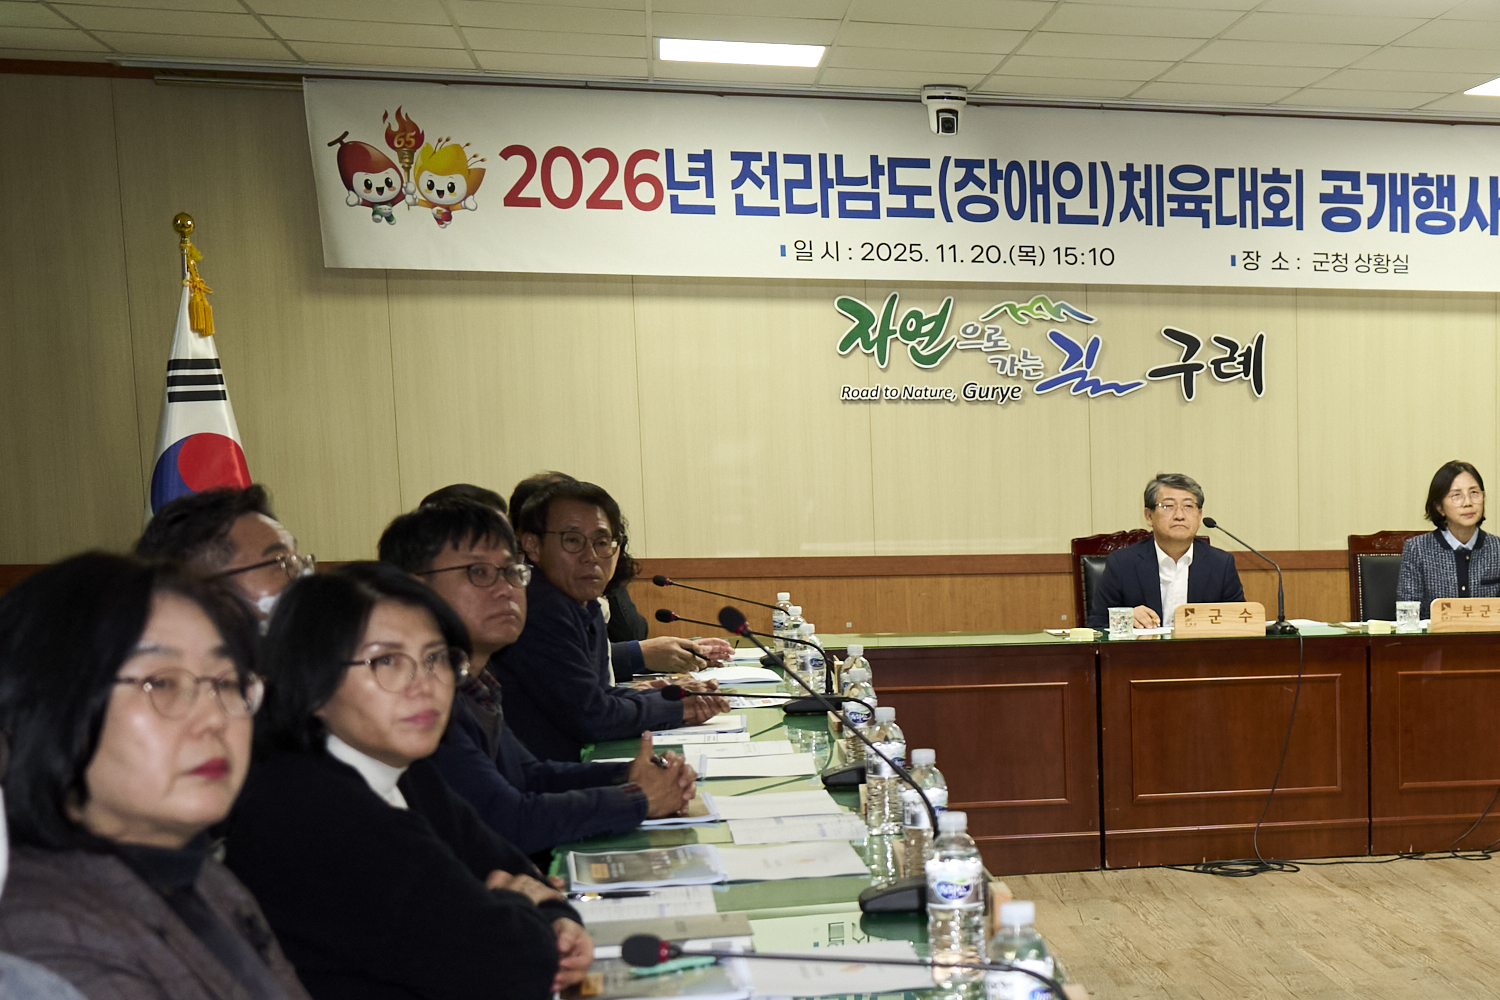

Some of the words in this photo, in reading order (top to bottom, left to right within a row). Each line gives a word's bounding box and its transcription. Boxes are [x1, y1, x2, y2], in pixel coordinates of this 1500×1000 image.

[393, 132, 416, 148] 65
[499, 144, 716, 216] 2026년
[730, 150, 1304, 234] 전라남도(장애인)체육대회
[860, 242, 929, 263] 2025.
[936, 243, 964, 263] 11.
[970, 243, 1046, 267] 20.(목)
[1053, 245, 1116, 267] 15:10
[1311, 251, 1350, 273] 군청
[1353, 252, 1410, 275] 상황실
[987, 349, 1044, 380] 가는
[1033, 329, 1147, 396] 길
[1146, 326, 1266, 401] 구례
[840, 384, 883, 402] Road
[884, 386, 899, 402] to
[901, 385, 957, 403] Nature,
[962, 382, 1022, 403] Gurye
